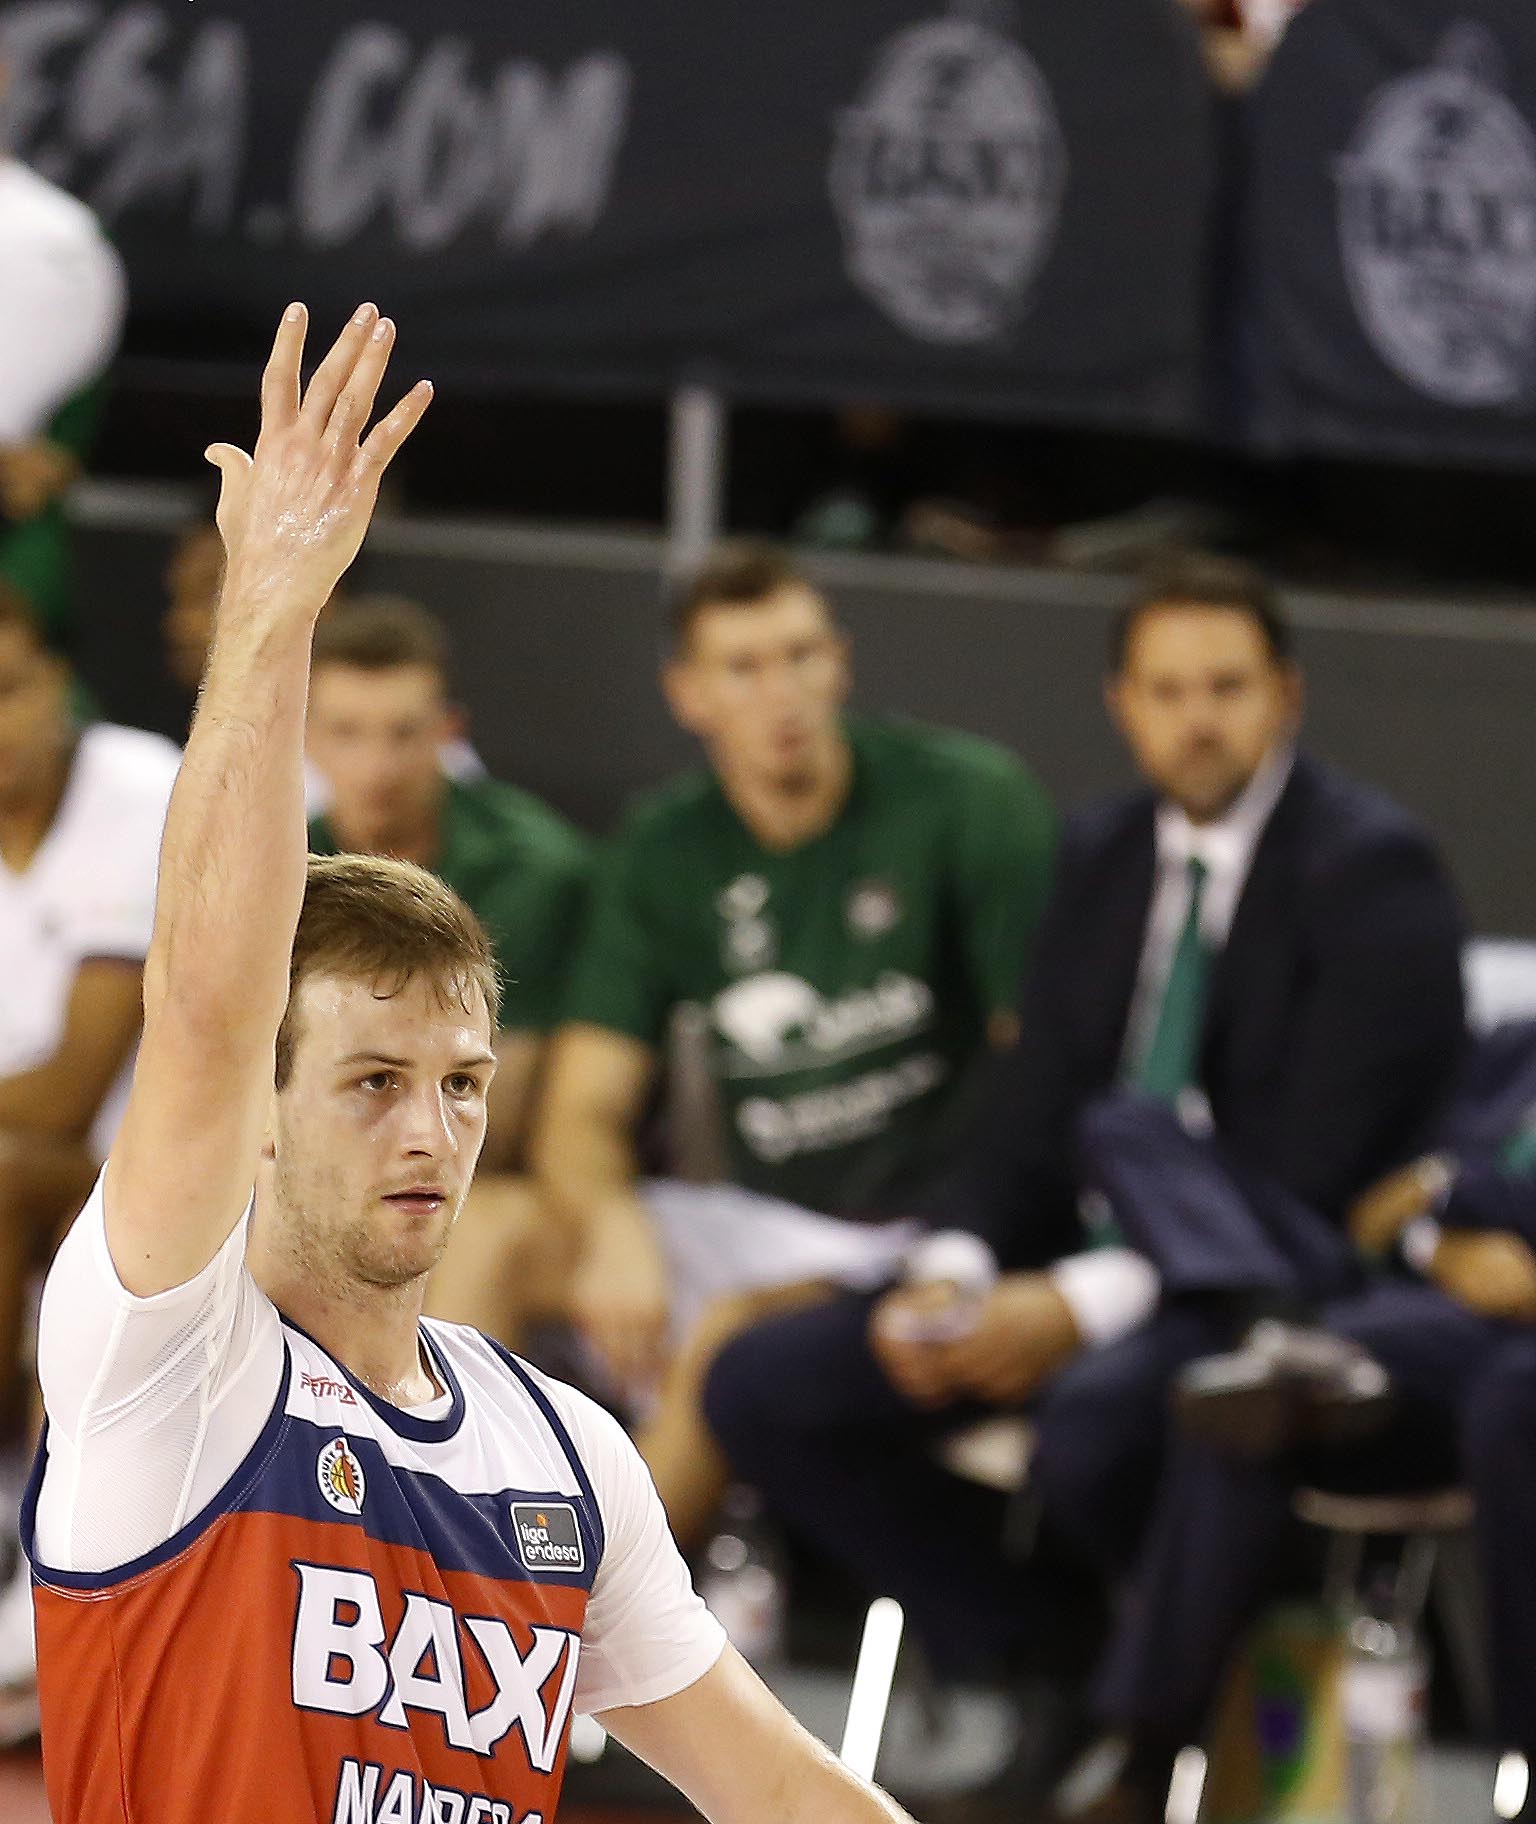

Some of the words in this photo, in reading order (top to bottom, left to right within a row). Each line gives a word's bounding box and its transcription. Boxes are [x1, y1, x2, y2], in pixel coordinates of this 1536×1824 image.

[519, 1522, 549, 1545] liga
[525, 1541, 579, 1562] endesa
[292, 1561, 582, 1774] BAXI
